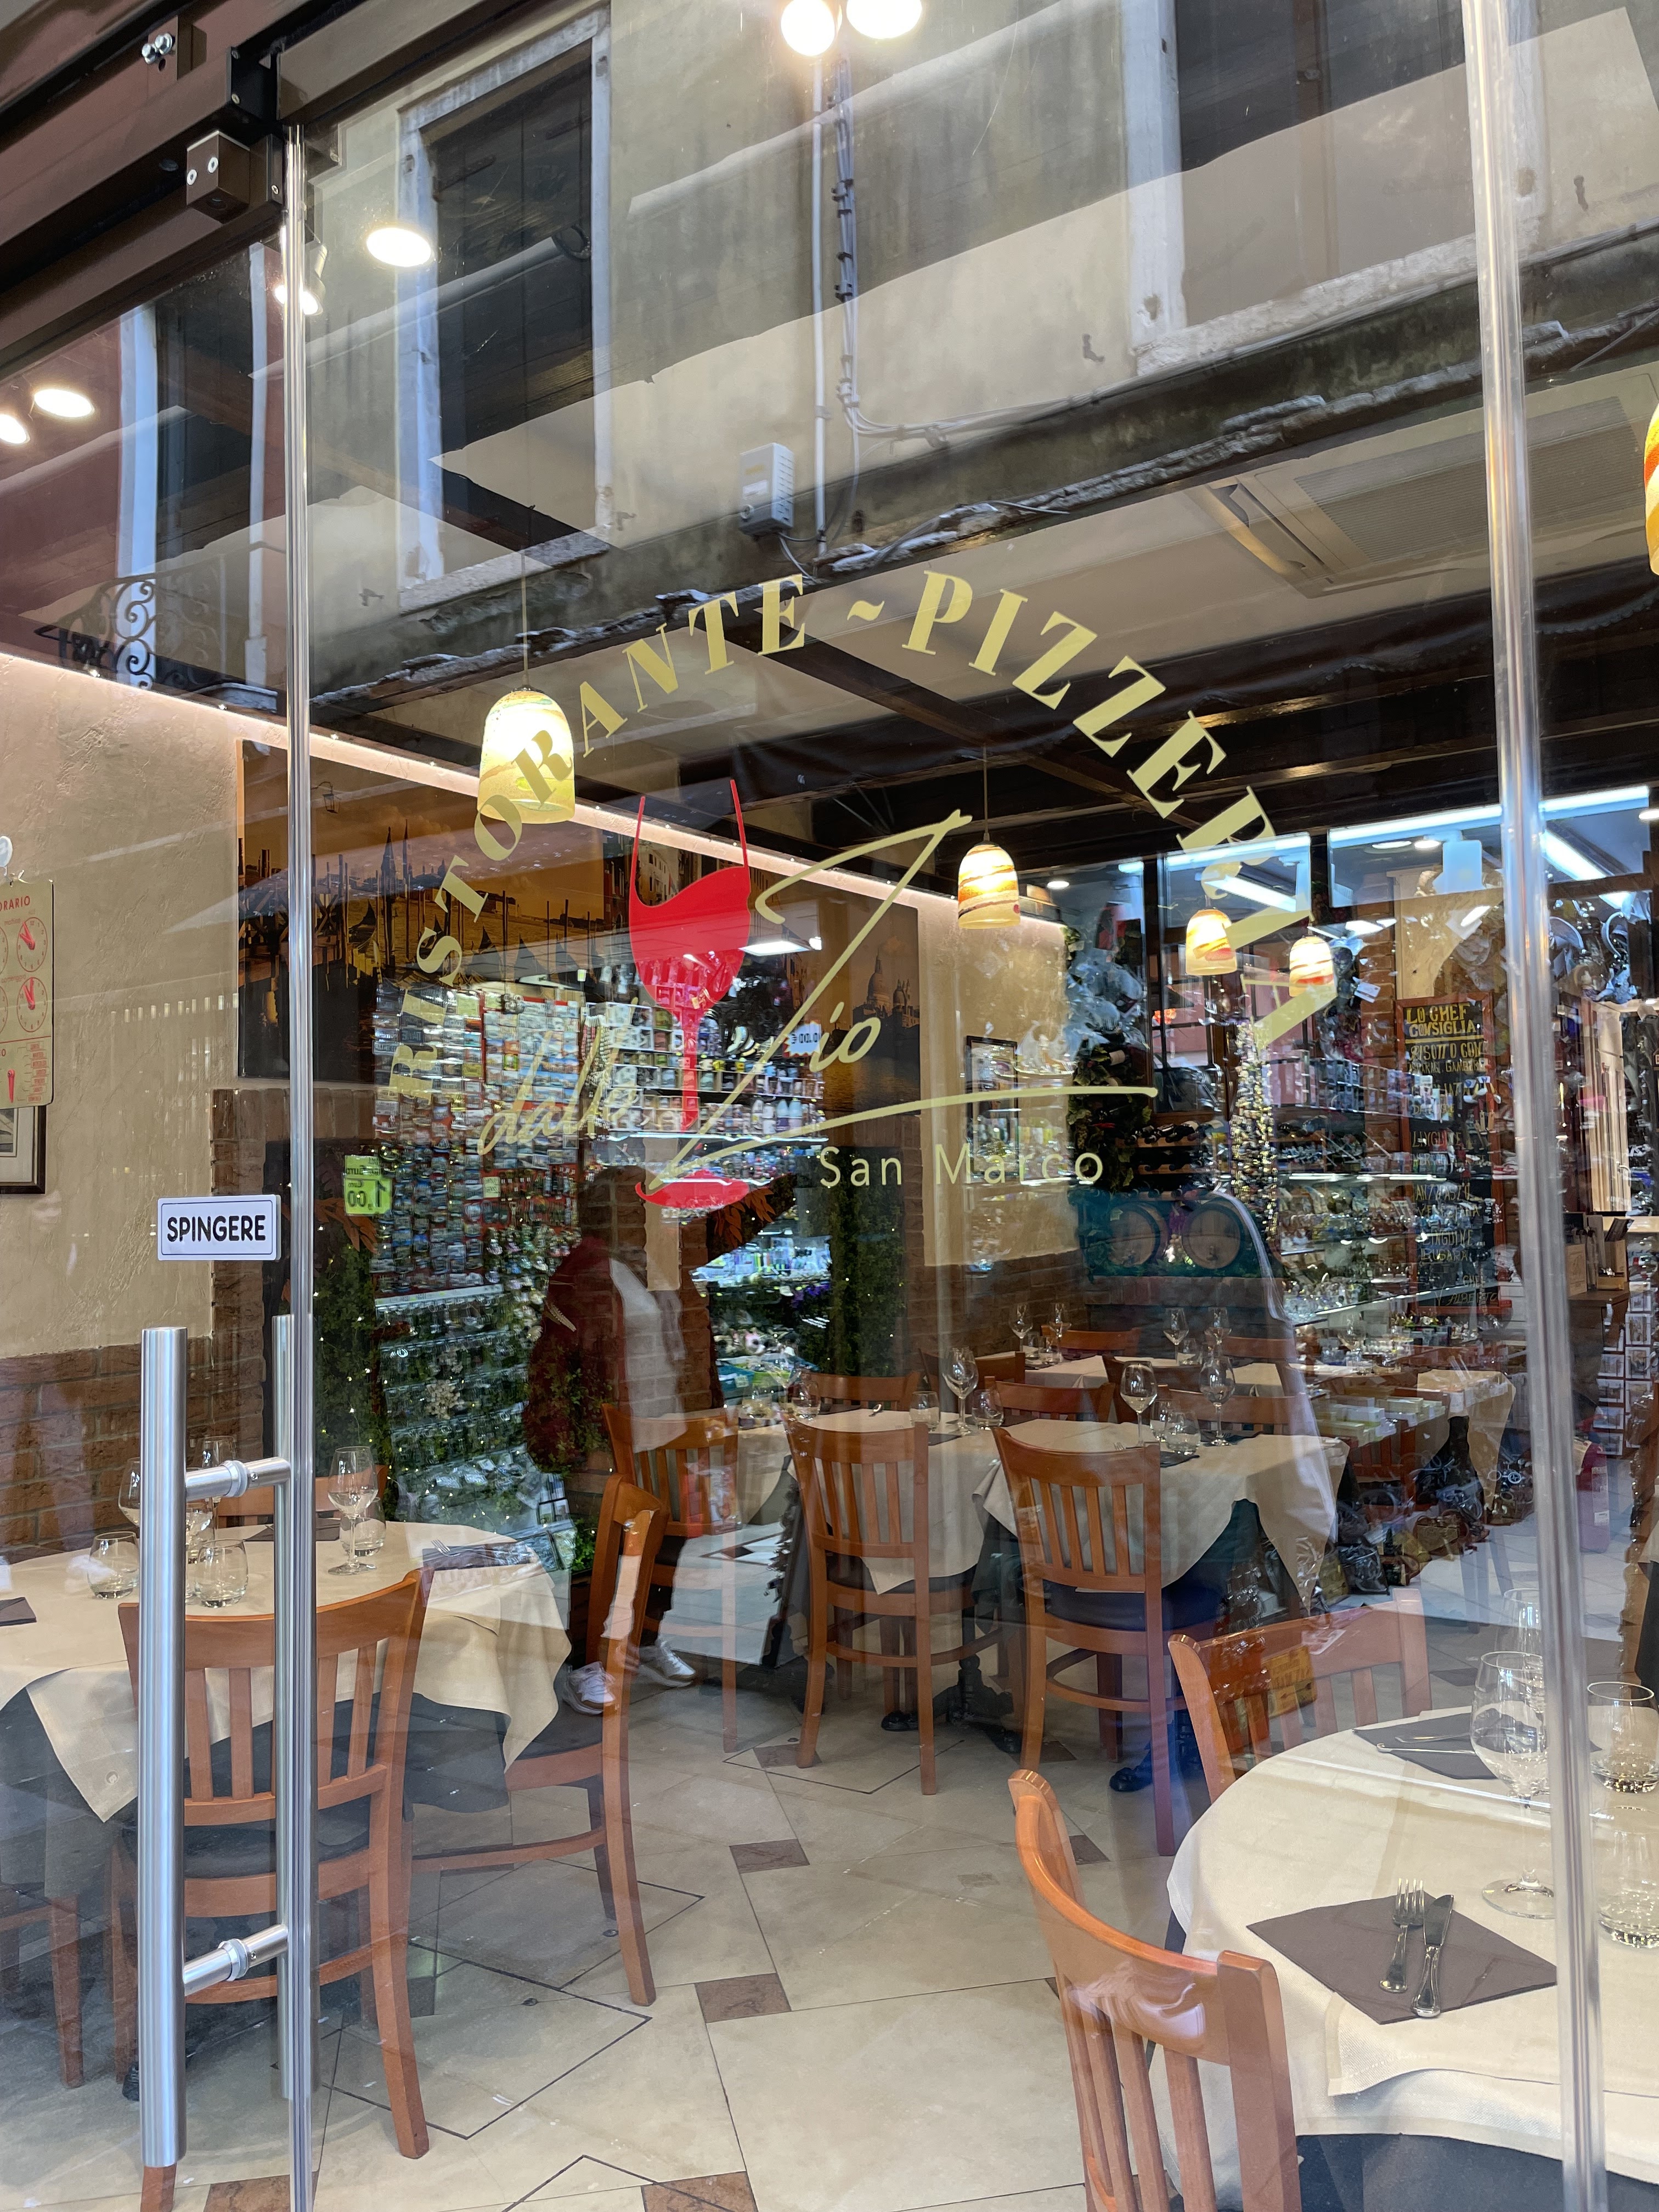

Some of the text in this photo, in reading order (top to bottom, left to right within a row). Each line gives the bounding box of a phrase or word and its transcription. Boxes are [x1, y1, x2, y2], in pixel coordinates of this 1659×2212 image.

[388, 574, 806, 1105] RISTORANTE
[901, 570, 1338, 1063] PIZZERIA
[649, 809, 1158, 1190] Zio
[1406, 1003, 1471, 1024] LO CHEF
[1409, 1019, 1476, 1037] CONSIGLIA
[1460, 1041, 1483, 1058] CON
[1412, 1130, 1462, 1148] LINGUIE
[820, 1143, 1103, 1188] San Marco
[167, 1215, 266, 1243] SPINGERE
